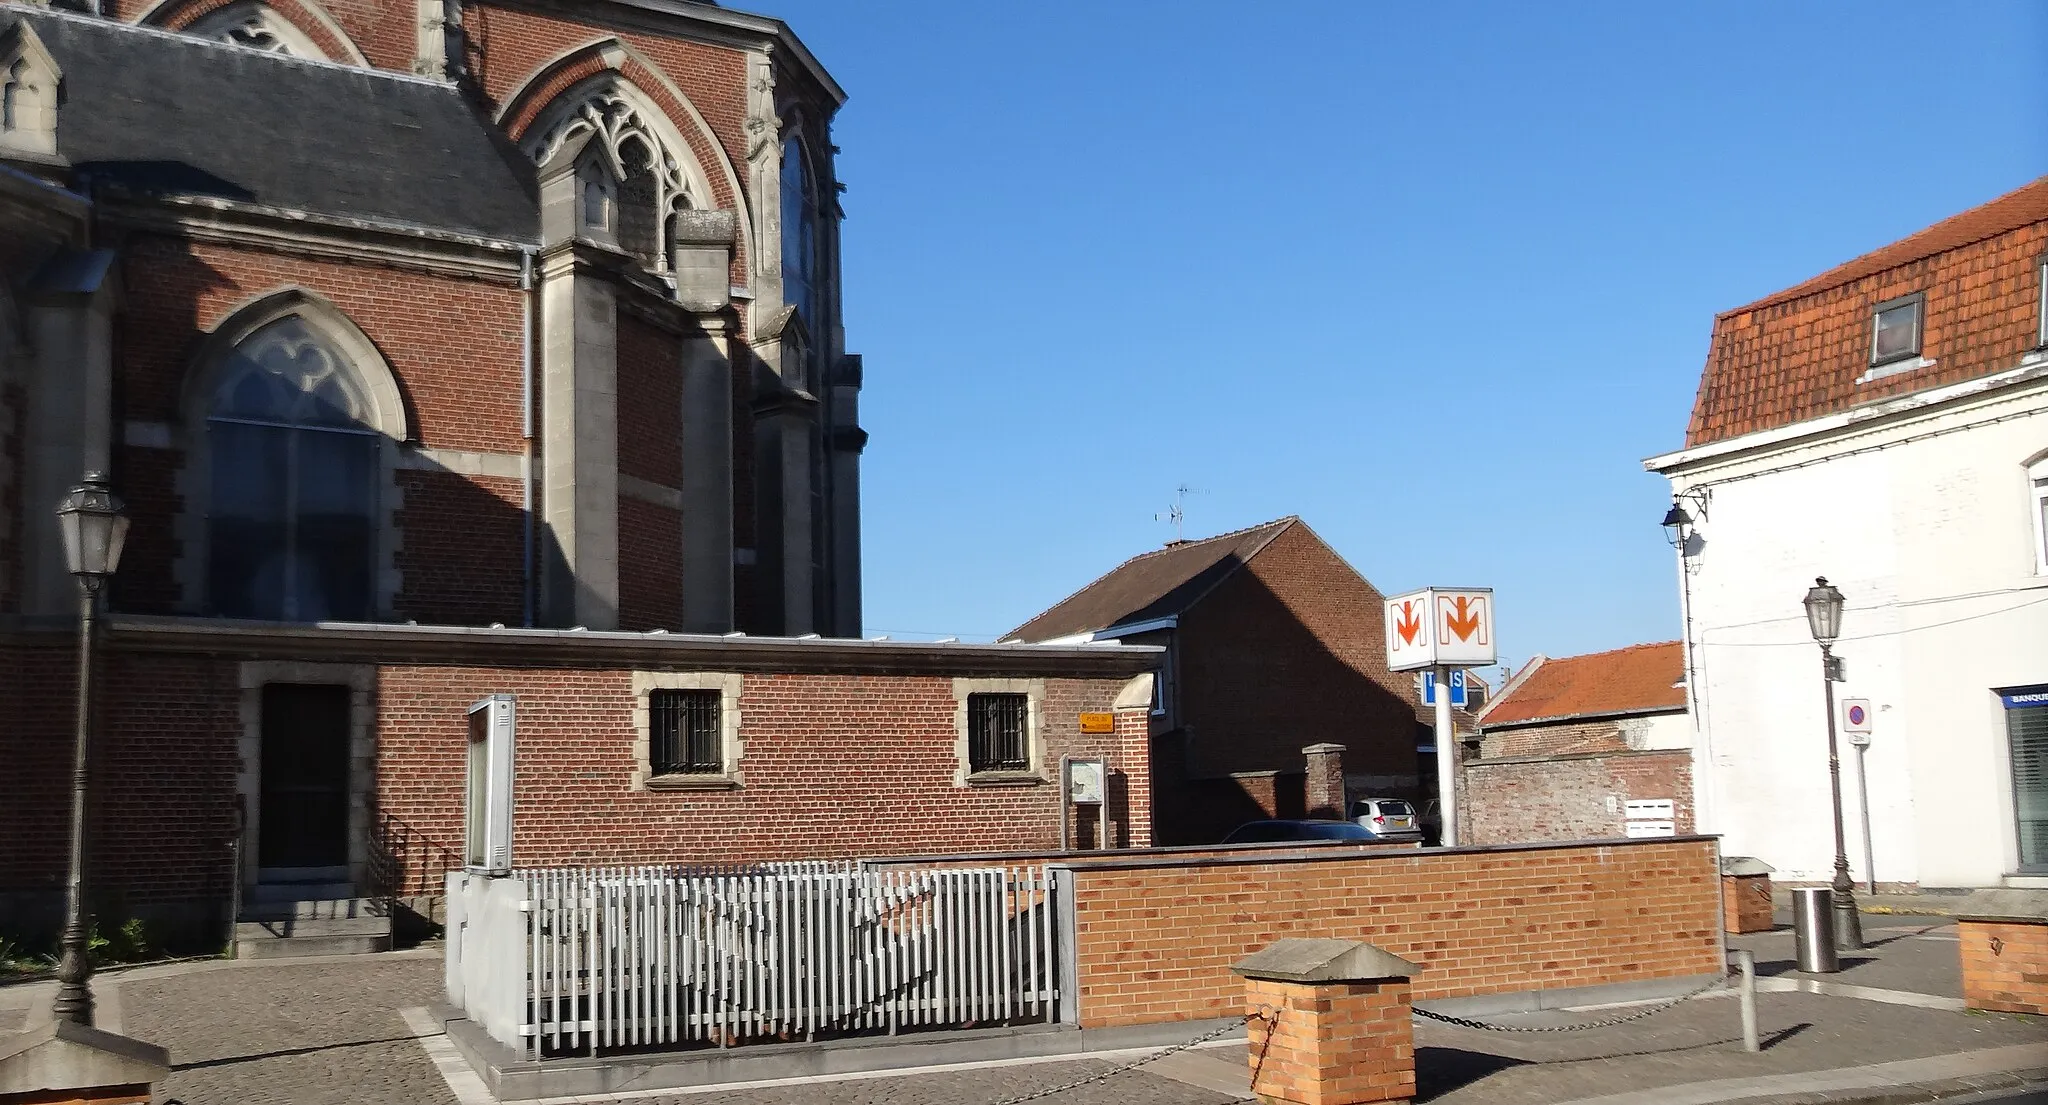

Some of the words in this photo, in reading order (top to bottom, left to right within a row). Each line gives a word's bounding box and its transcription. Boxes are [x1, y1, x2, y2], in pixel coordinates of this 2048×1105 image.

[1391, 598, 1427, 651] M
[1437, 596, 1488, 645] M
[1426, 671, 1462, 688] TIS
